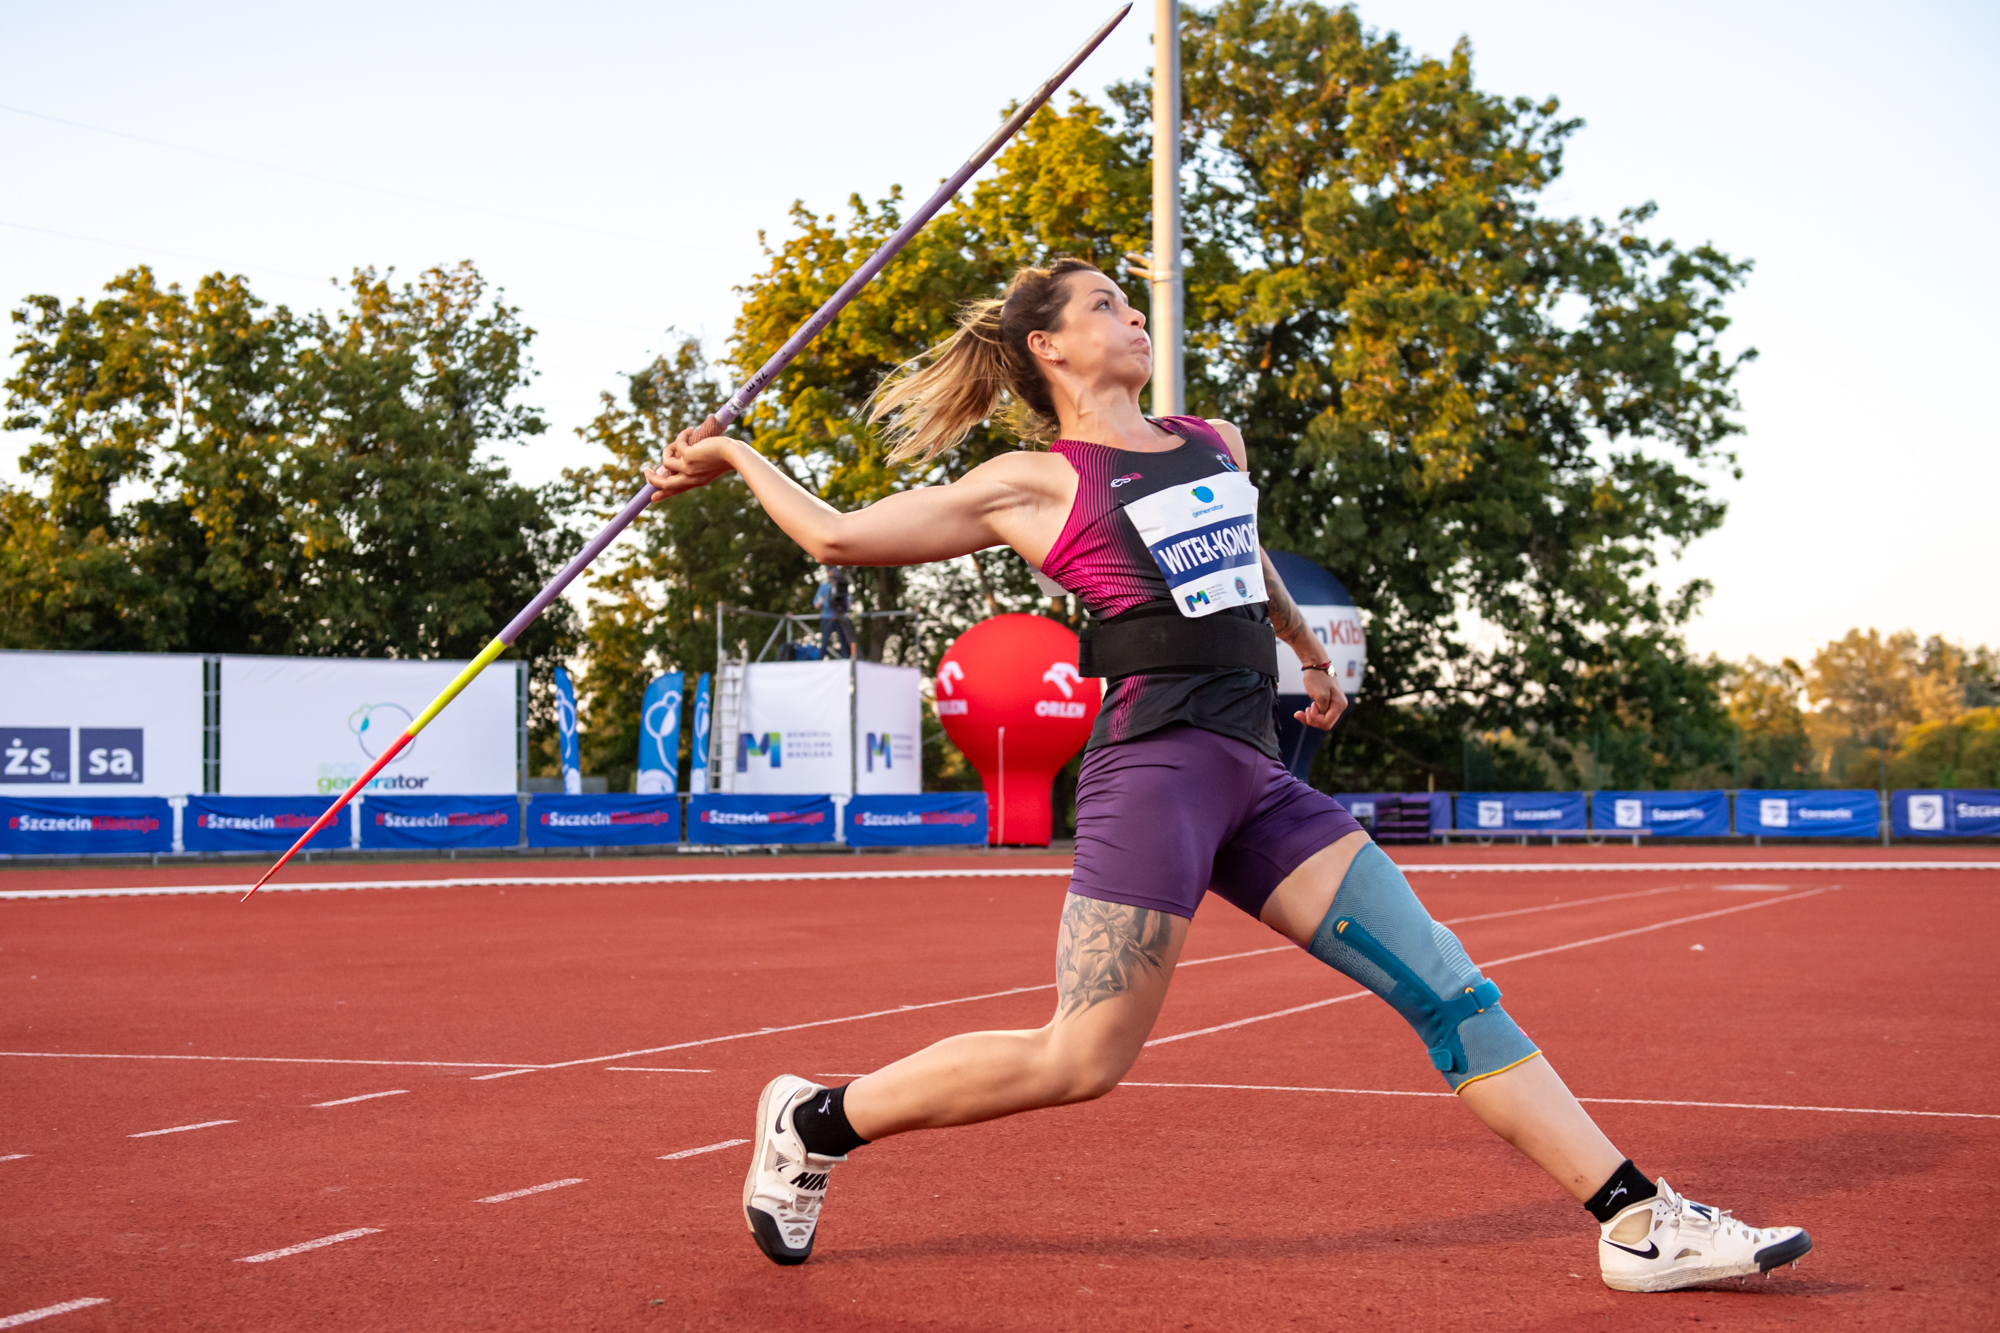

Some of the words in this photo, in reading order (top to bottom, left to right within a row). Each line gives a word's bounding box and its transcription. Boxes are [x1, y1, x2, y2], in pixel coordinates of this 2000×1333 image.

[1192, 504, 1224, 518] generator
[1035, 700, 1086, 718] ORLEN
[88, 748, 133, 775] sa
[9, 815, 160, 834] #SzczecinKibicuje
[789, 1172, 830, 1191] NIK
